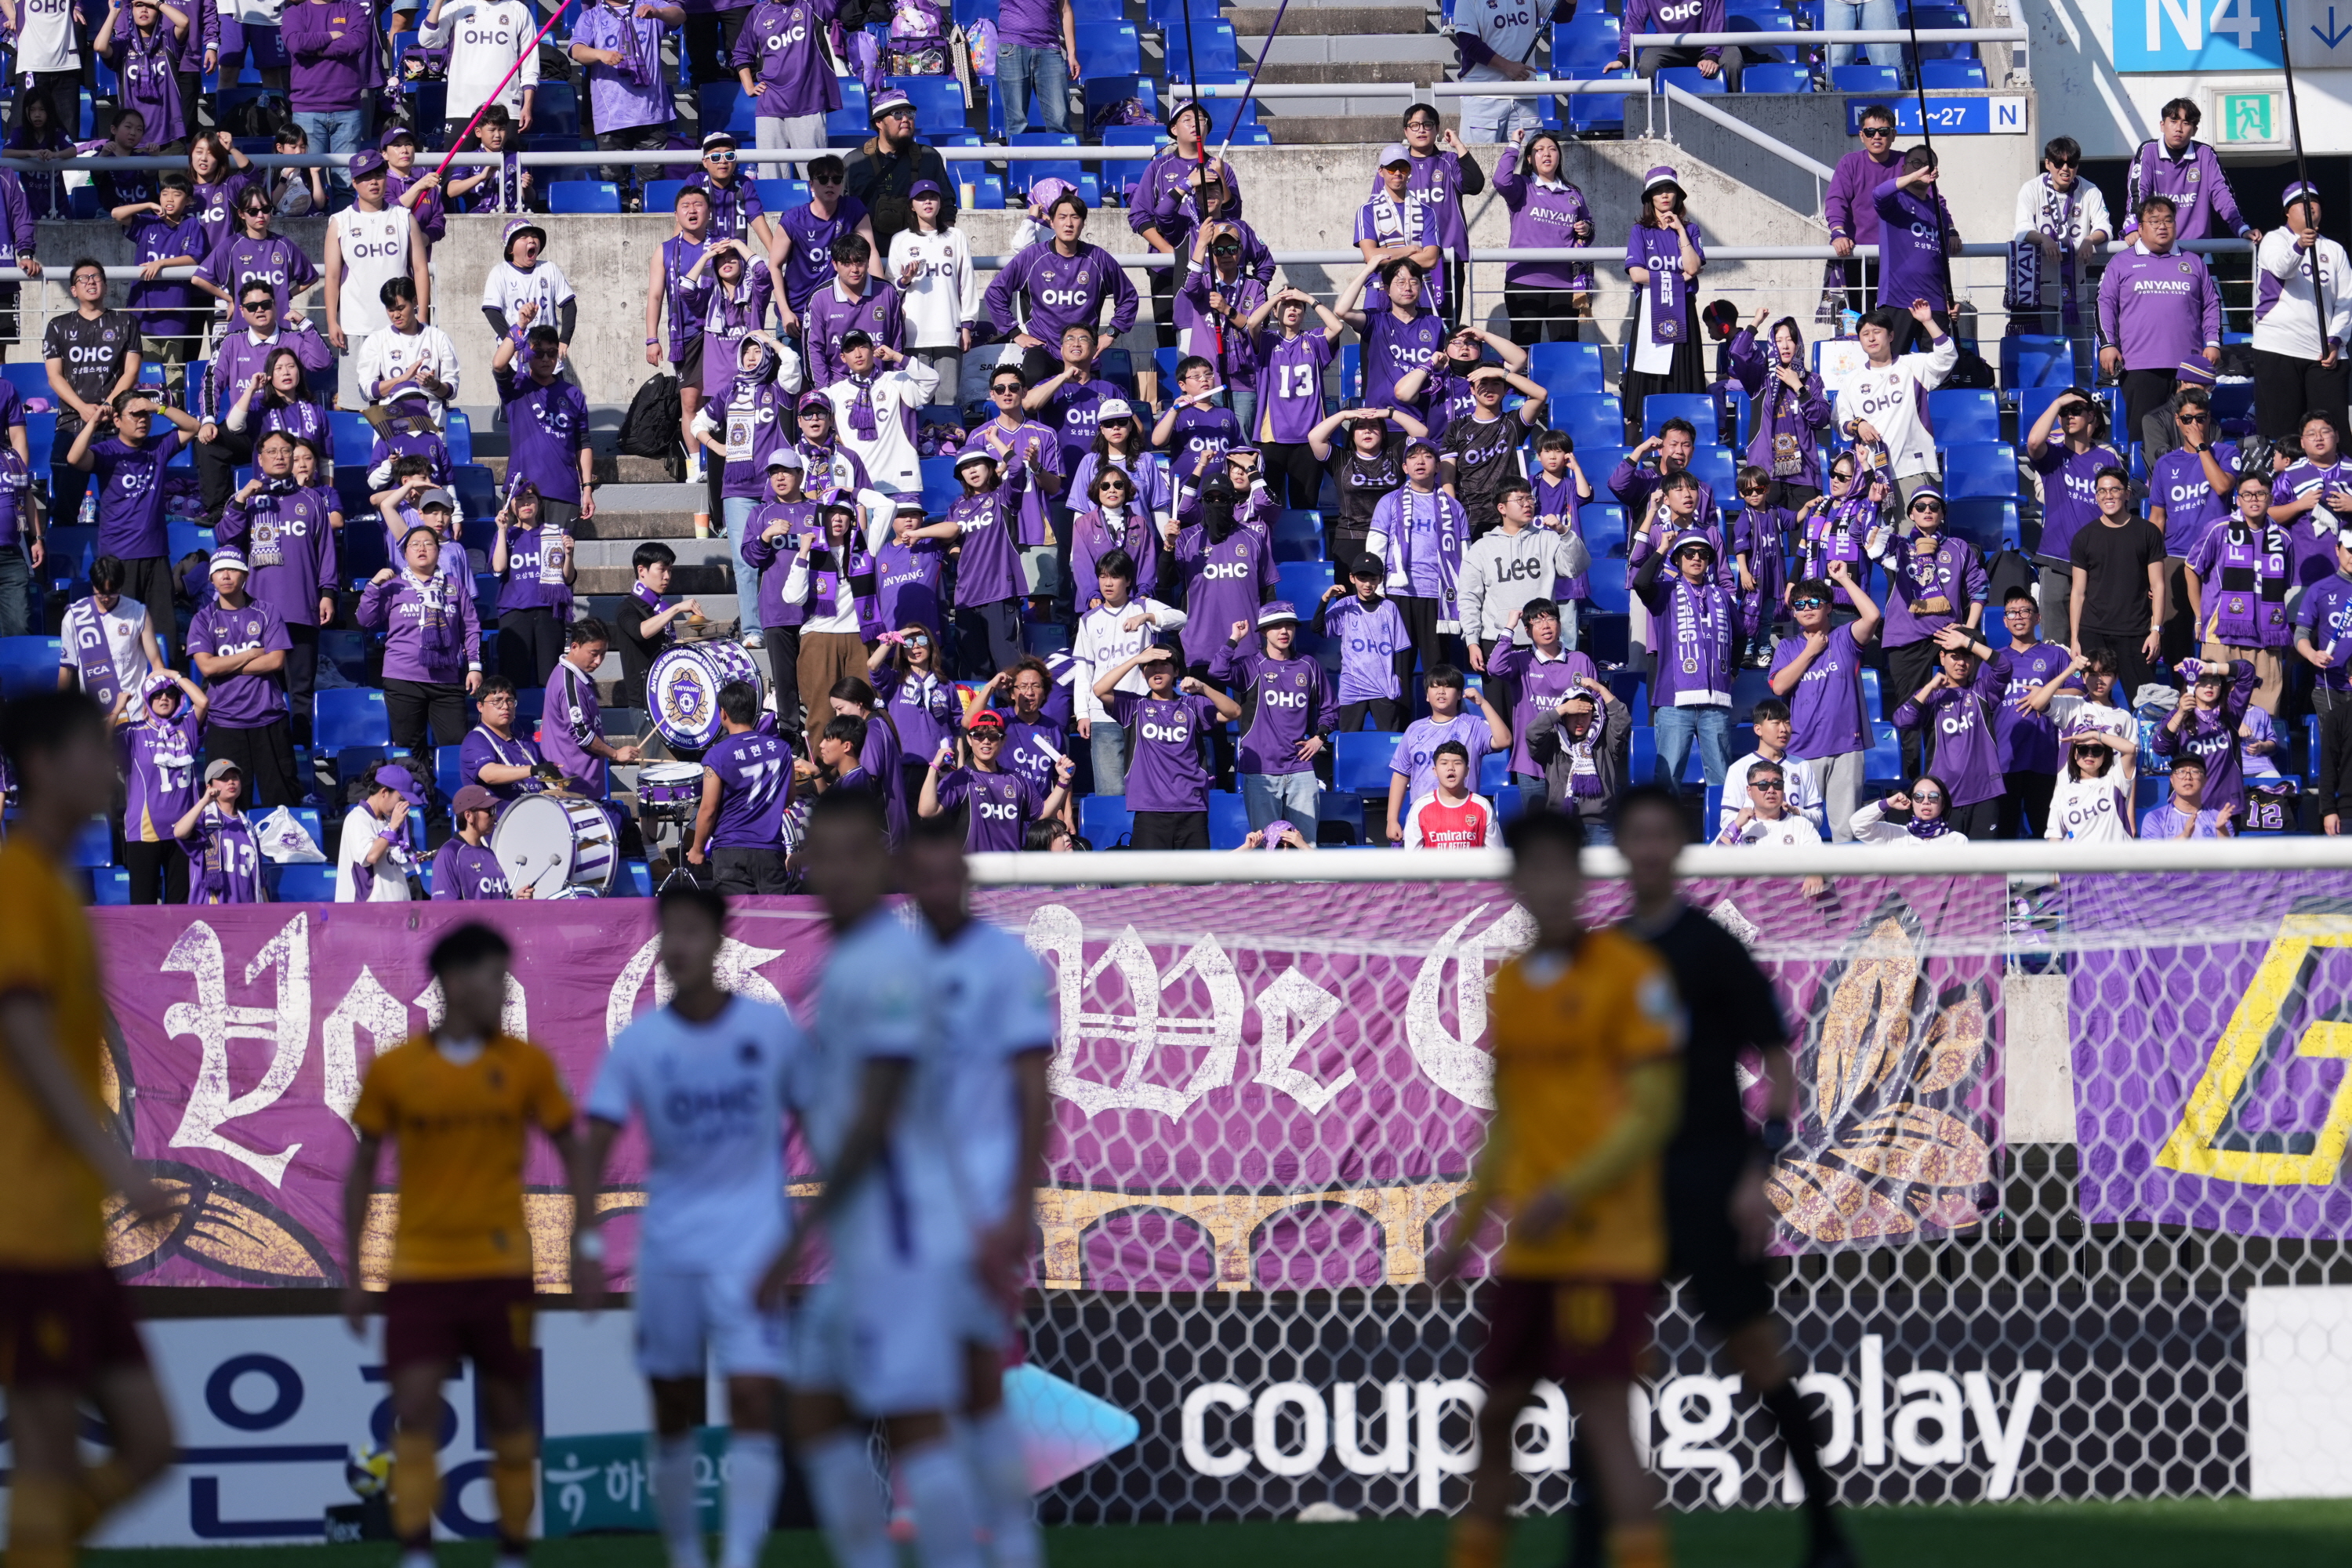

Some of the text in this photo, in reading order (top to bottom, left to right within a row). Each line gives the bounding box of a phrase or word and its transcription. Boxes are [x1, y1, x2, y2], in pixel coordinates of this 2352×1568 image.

[1494, 11, 1530, 29] OHC
[1659, 1, 1702, 21] OHC
[2147, 0, 2260, 51] N4
[464, 30, 509, 45] OHC
[605, 30, 648, 48] OC
[767, 26, 806, 50] OHC
[127, 64, 167, 80] OC
[1915, 107, 1966, 125] 1~27
[1999, 105, 2016, 125] N
[198, 207, 225, 223] HC
[1530, 207, 1578, 223] ANYANG
[1534, 217, 1561, 227] FOOTBALL
[2040, 223, 2082, 238] OC
[354, 241, 398, 257] OHC
[809, 248, 832, 262] OH
[2300, 263, 2329, 284] OC
[2134, 281, 2190, 292] ANYANG
[1042, 289, 1087, 306] OHC
[69, 346, 113, 362] OHC
[1390, 344, 1432, 362] OHC
[390, 365, 431, 379] OC
[1279, 363, 1314, 398] 13
[1862, 390, 1904, 415] OHC
[1066, 408, 1096, 424] OH
[1189, 437, 1229, 452] OHC
[1465, 438, 1508, 464] OHC
[1351, 473, 1397, 487] OHC
[279, 521, 307, 536] HC
[956, 511, 993, 533] OHC
[771, 534, 802, 549] OH
[510, 552, 540, 570] OH
[1494, 557, 1541, 583] Lee
[515, 572, 541, 580] 오상헬스
[883, 569, 924, 589] ANYANG
[1203, 563, 1248, 579] OHC
[1098, 641, 1139, 662] OHC
[1351, 638, 1392, 657] OHC
[663, 650, 702, 664] SUPPORTERS
[87, 665, 110, 677] FCA
[1265, 690, 1307, 708] OHC
[665, 727, 710, 746] LEADING TEAM
[1142, 721, 1188, 742] OHC
[2187, 736, 2228, 757] OHC
[1013, 747, 1051, 771] OHC
[980, 802, 1018, 820] OHC
[2068, 797, 2112, 826] OHC
[2246, 800, 2283, 829] 12
[1428, 830, 1476, 841] Emirates
[223, 838, 256, 877] 13
